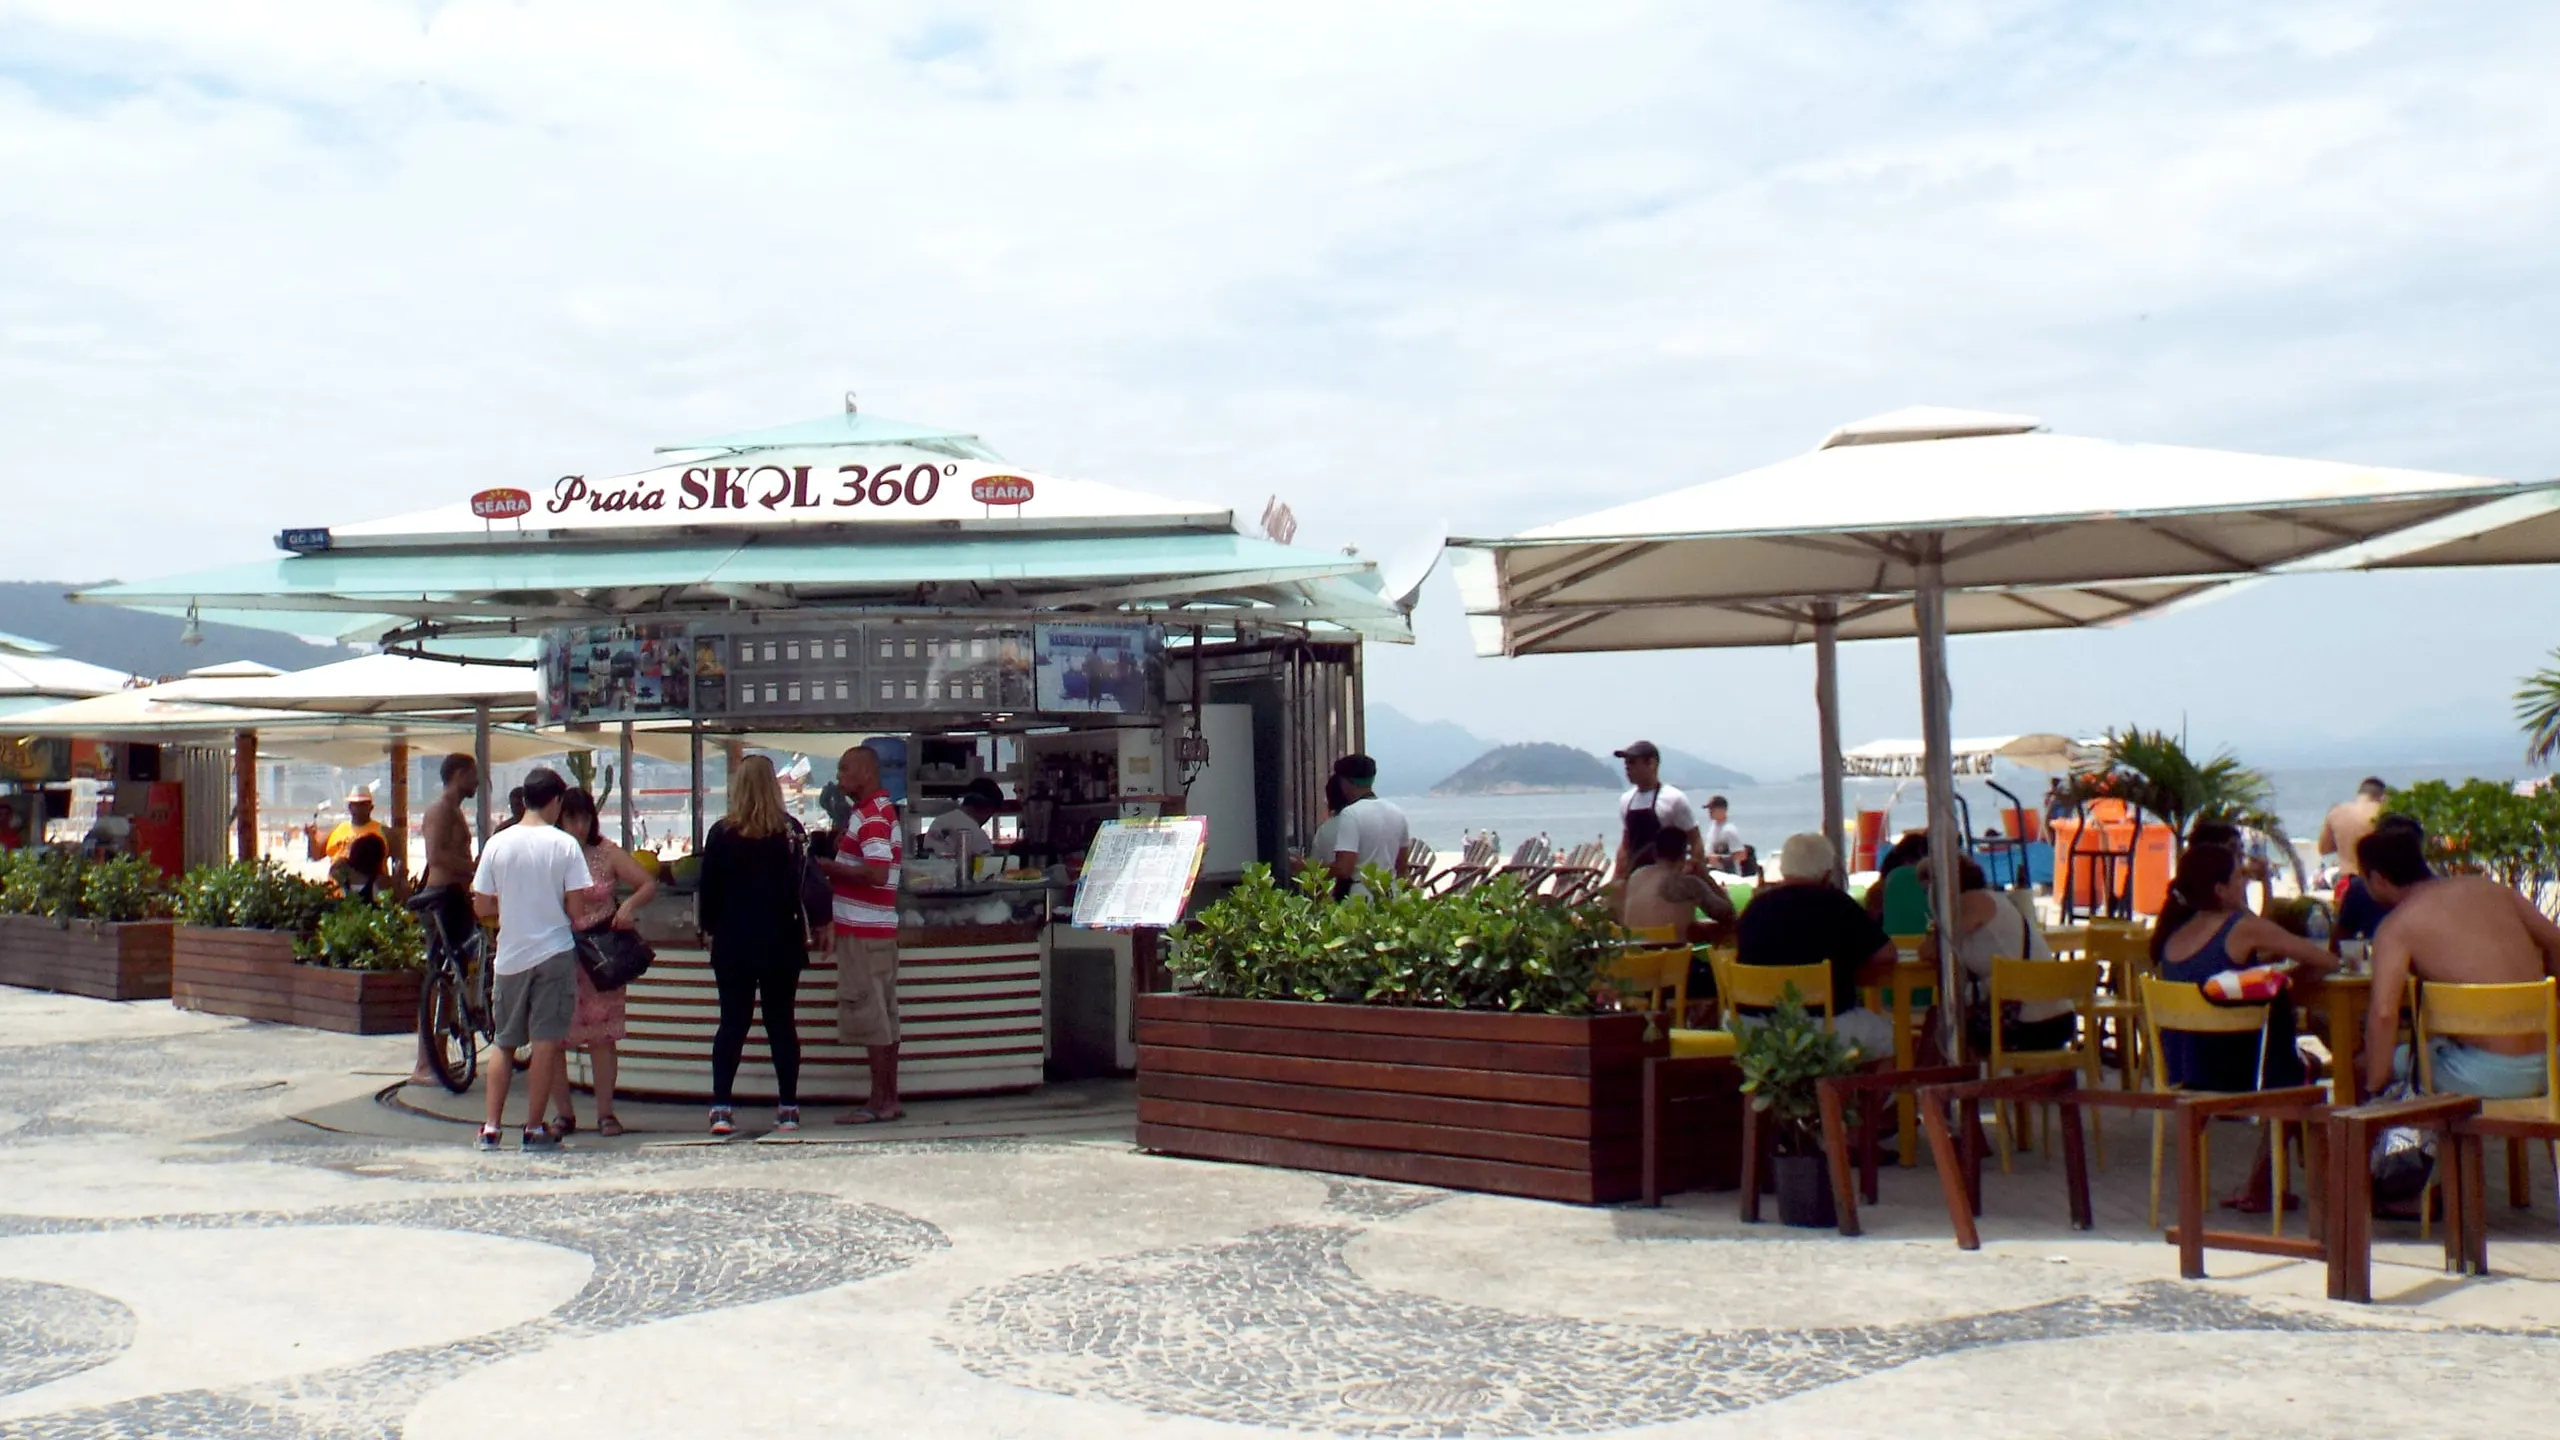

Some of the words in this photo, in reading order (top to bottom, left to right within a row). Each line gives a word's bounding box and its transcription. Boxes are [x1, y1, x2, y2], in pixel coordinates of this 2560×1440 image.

[546, 475, 666, 513] Praia
[974, 485, 1031, 499] SEARA
[474, 499, 529, 514] SEARA
